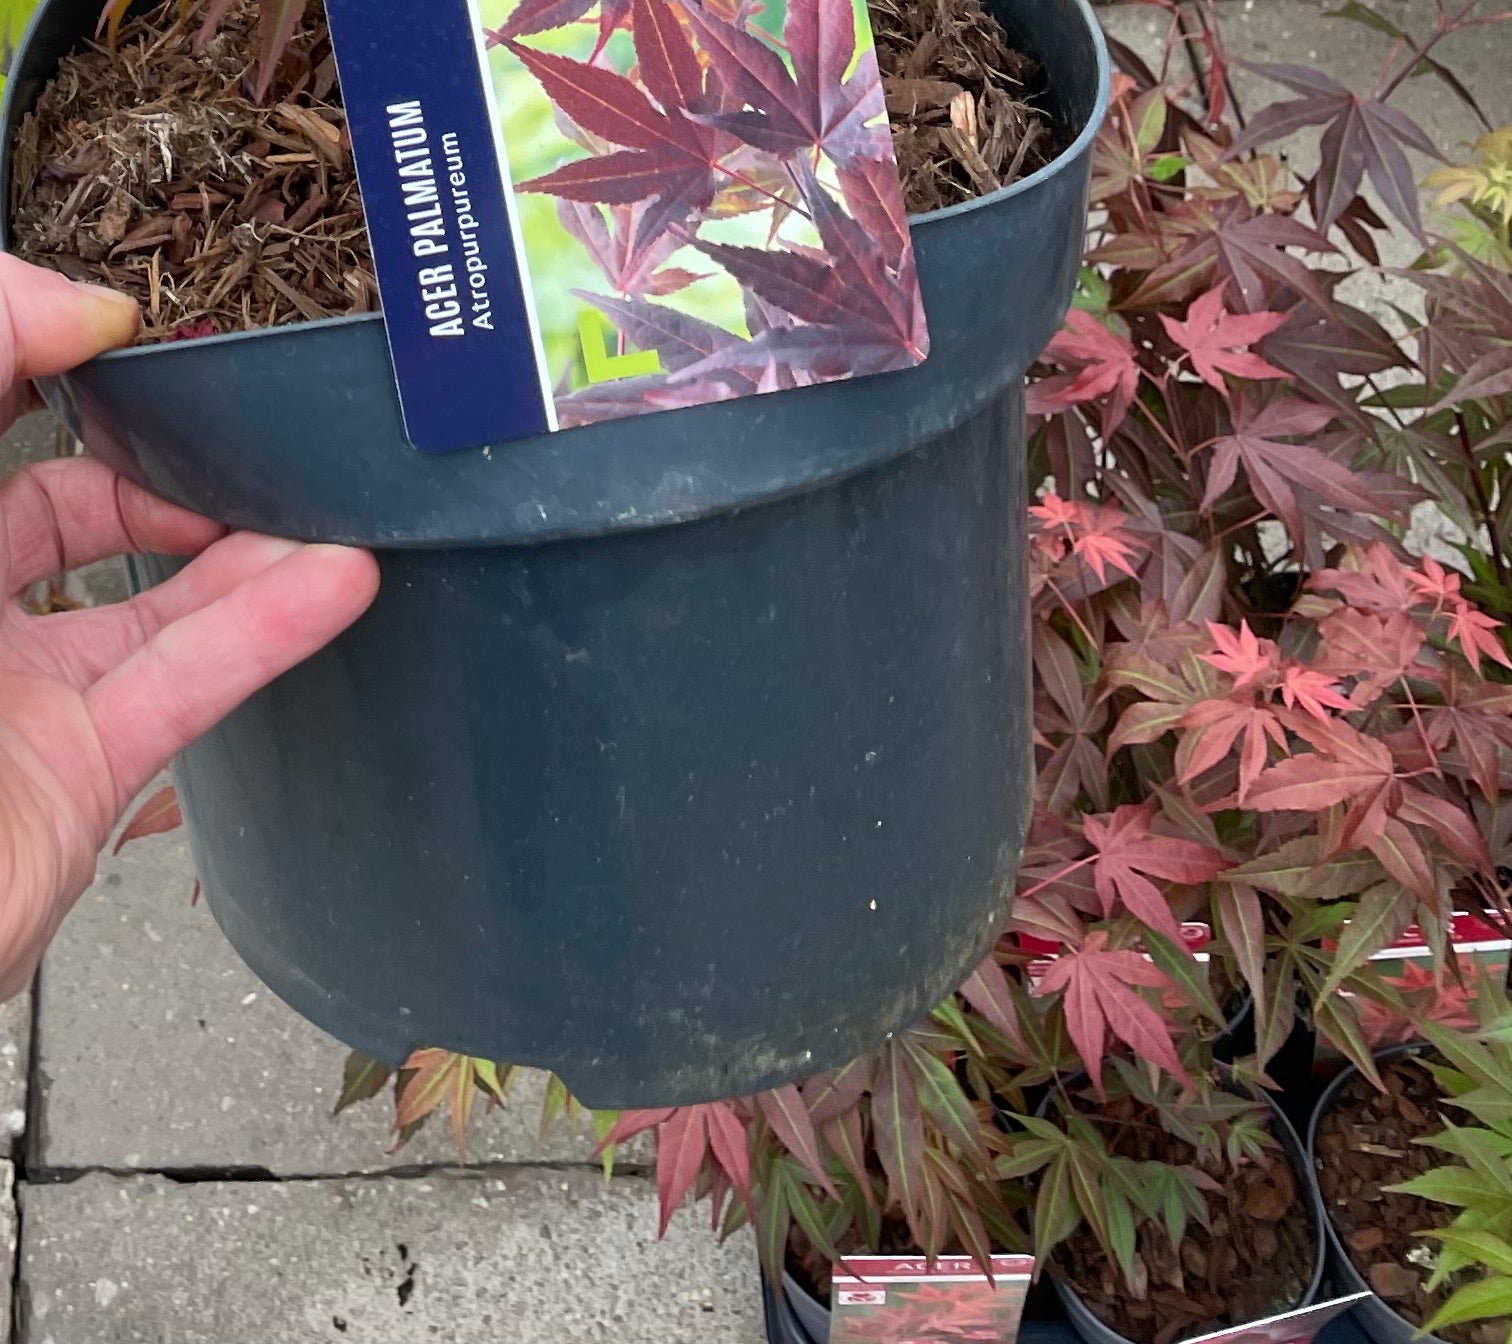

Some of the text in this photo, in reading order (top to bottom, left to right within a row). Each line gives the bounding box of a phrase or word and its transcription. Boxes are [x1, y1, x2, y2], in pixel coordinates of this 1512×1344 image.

[386, 100, 465, 337] ACER PALMATUM
[441, 132, 495, 330] Atropurpureum
